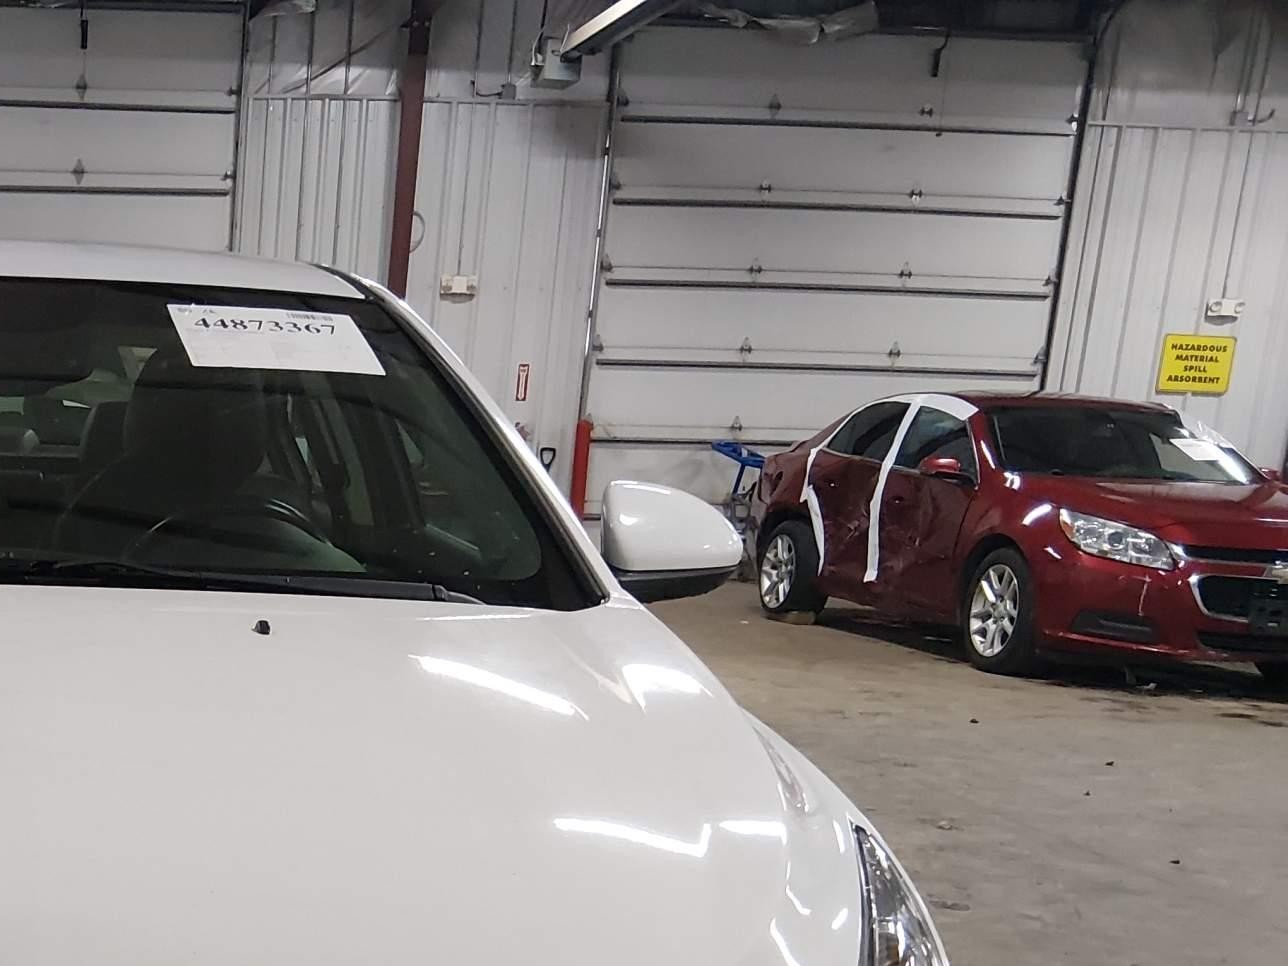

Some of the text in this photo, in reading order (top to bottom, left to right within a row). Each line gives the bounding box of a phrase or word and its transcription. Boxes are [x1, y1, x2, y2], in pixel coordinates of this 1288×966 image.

[194, 317, 335, 336] 44873367
[1171, 343, 1228, 353] HAZARDOUS
[1175, 354, 1219, 363] MATERIAL
[1183, 365, 1207, 373] SPILL
[1166, 375, 1220, 384] ABSORBENT
